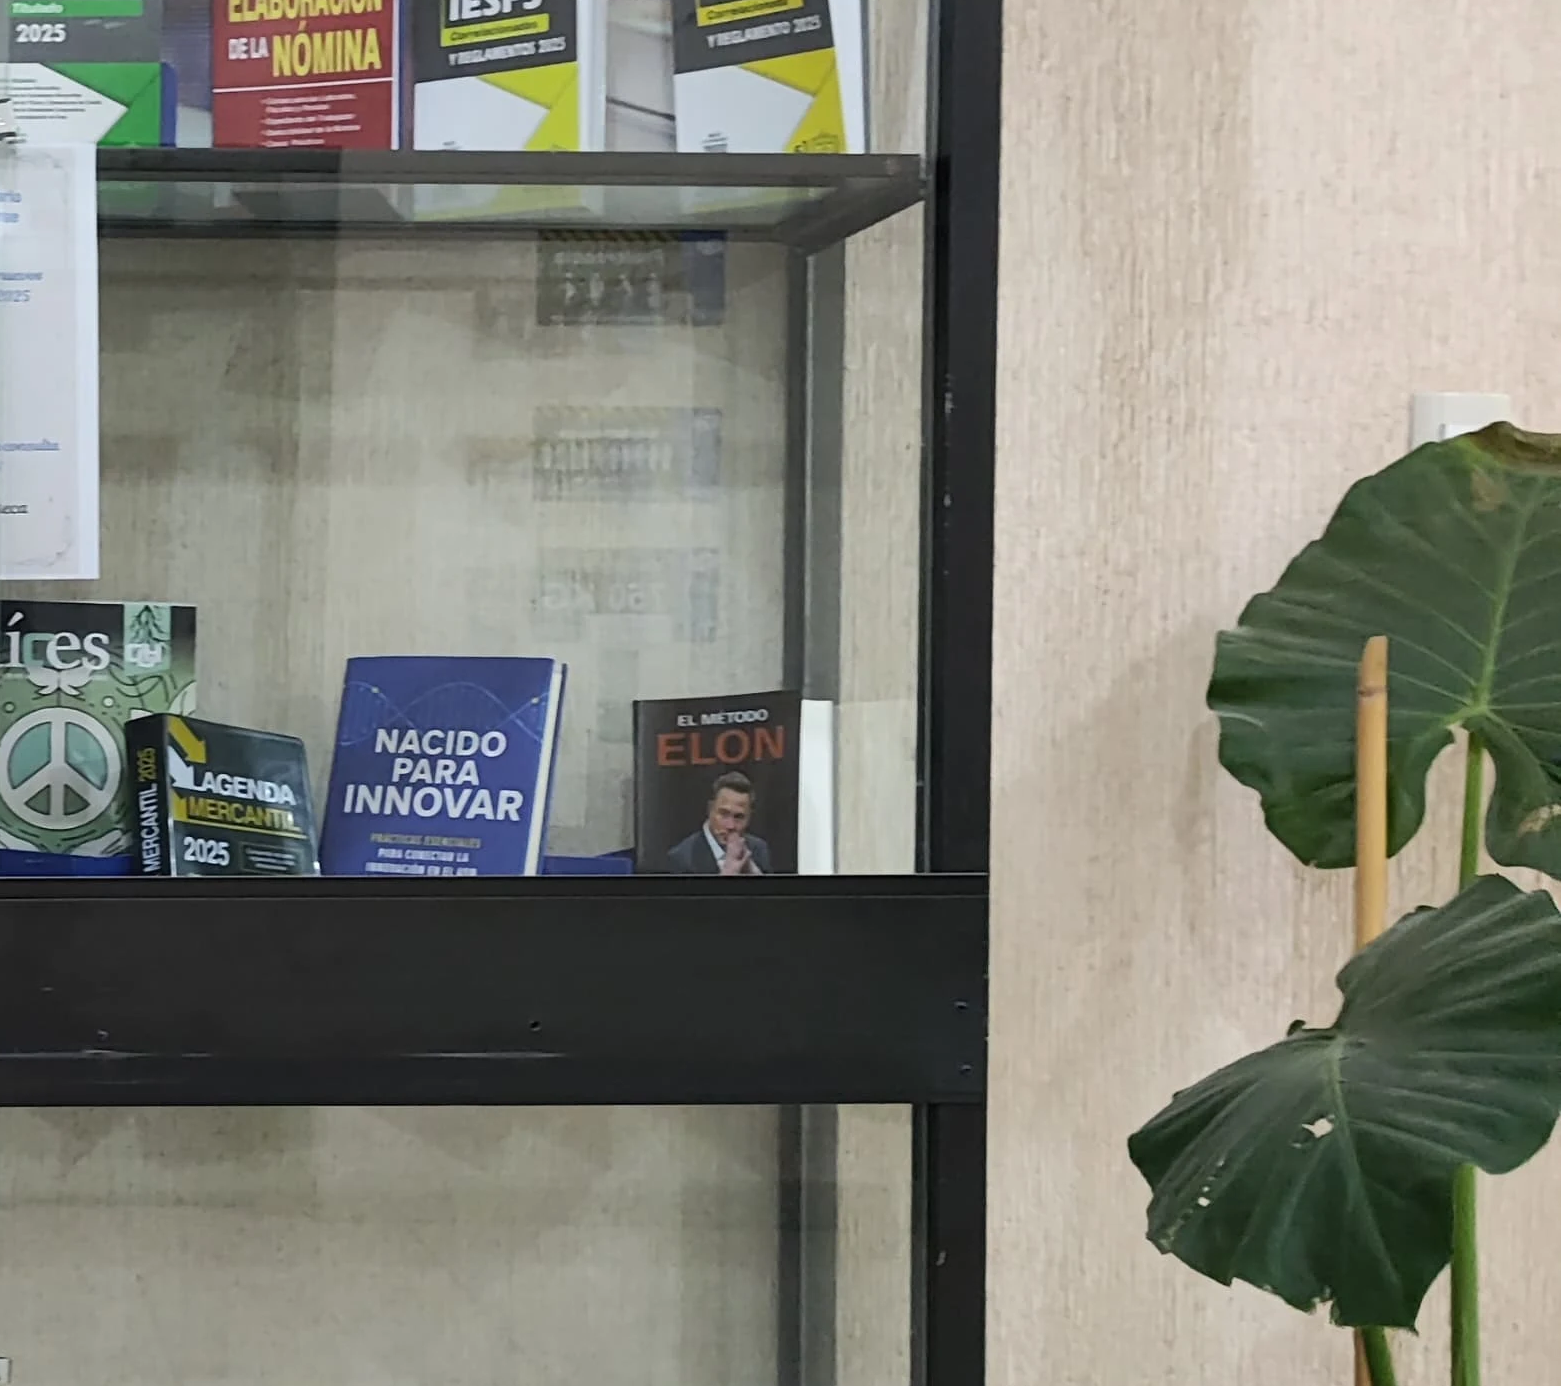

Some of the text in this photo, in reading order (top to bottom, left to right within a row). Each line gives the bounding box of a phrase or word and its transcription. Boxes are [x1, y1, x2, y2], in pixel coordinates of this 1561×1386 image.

[15, 23, 67, 43] 2025
[228, 20, 383, 78] DE LA NÓMINA
[677, 708, 769, 727] EL MÉTODO
[374, 728, 508, 758] NACIDO
[656, 724, 785, 767] ELON
[201, 771, 297, 806] AGENDA
[391, 757, 480, 786] PARA
[138, 747, 162, 873] MERCANTIL 2025
[188, 795, 303, 833] MERCANTIL
[343, 783, 524, 822] INNOVAR
[183, 836, 231, 867] 2025
